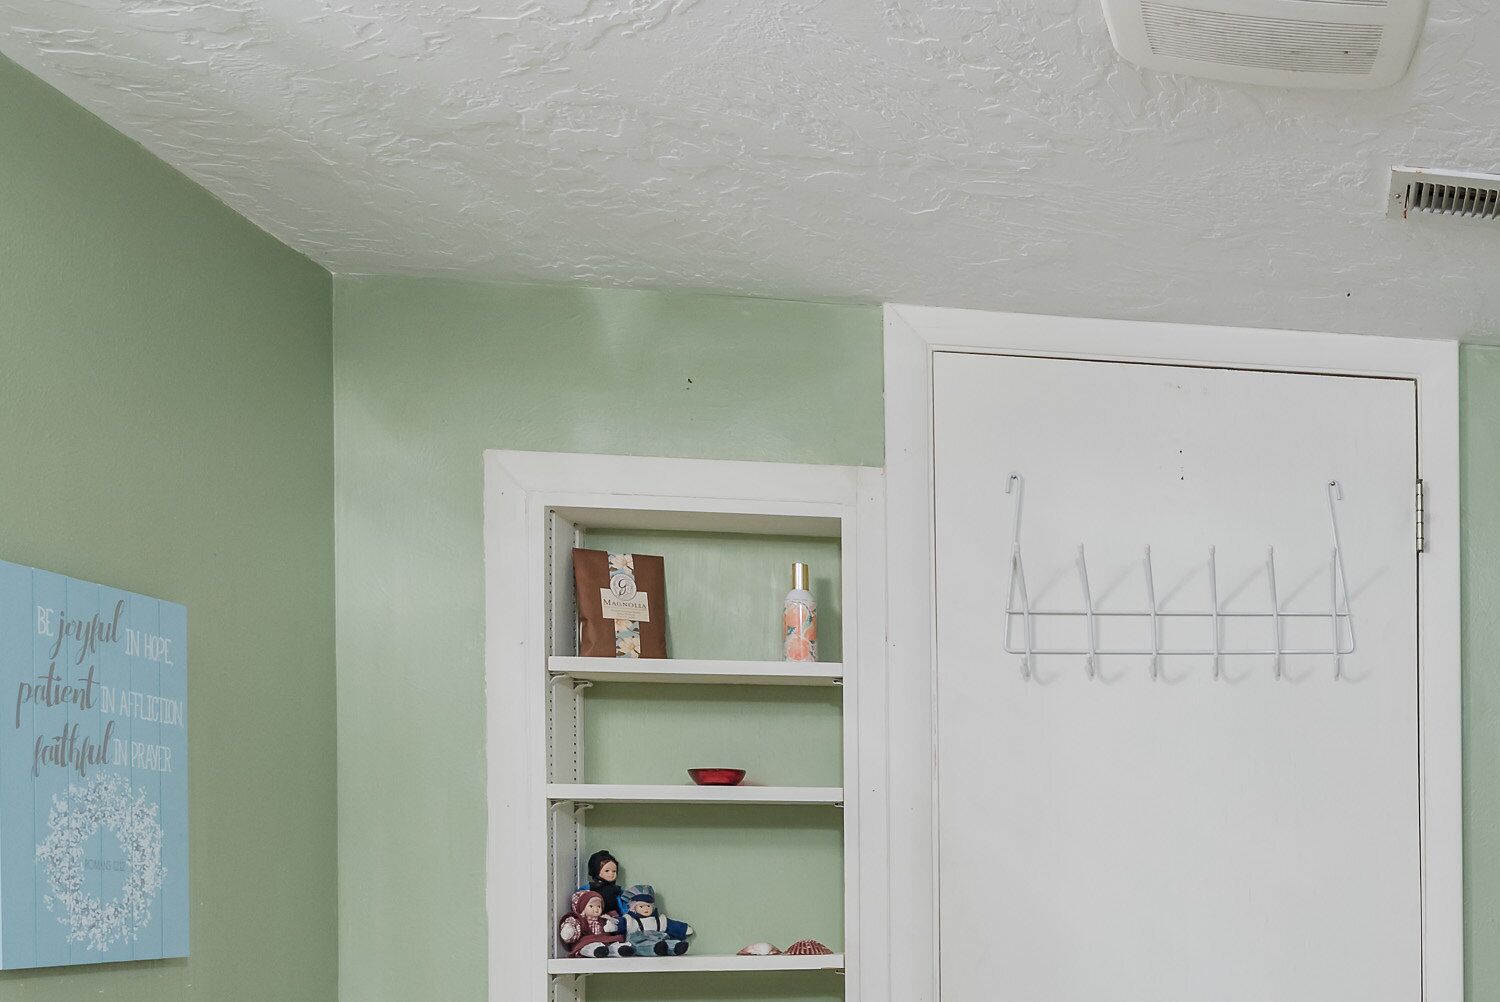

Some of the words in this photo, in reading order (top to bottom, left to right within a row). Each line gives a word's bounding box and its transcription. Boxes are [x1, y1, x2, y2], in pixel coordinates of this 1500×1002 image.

[37, 605, 54, 637] BE
[50, 599, 124, 665] joyful
[125, 628, 140, 657] IN
[144, 633, 174, 668] HOPE,
[603, 598, 646, 608] MAGNOLIA
[16, 661, 100, 729] patient
[100, 686, 115, 713] IN
[119, 691, 184, 729] AFFLICTION
[32, 720, 114, 779] faithful
[113, 738, 128, 765] IN
[131, 742, 173, 772] PRAYER
